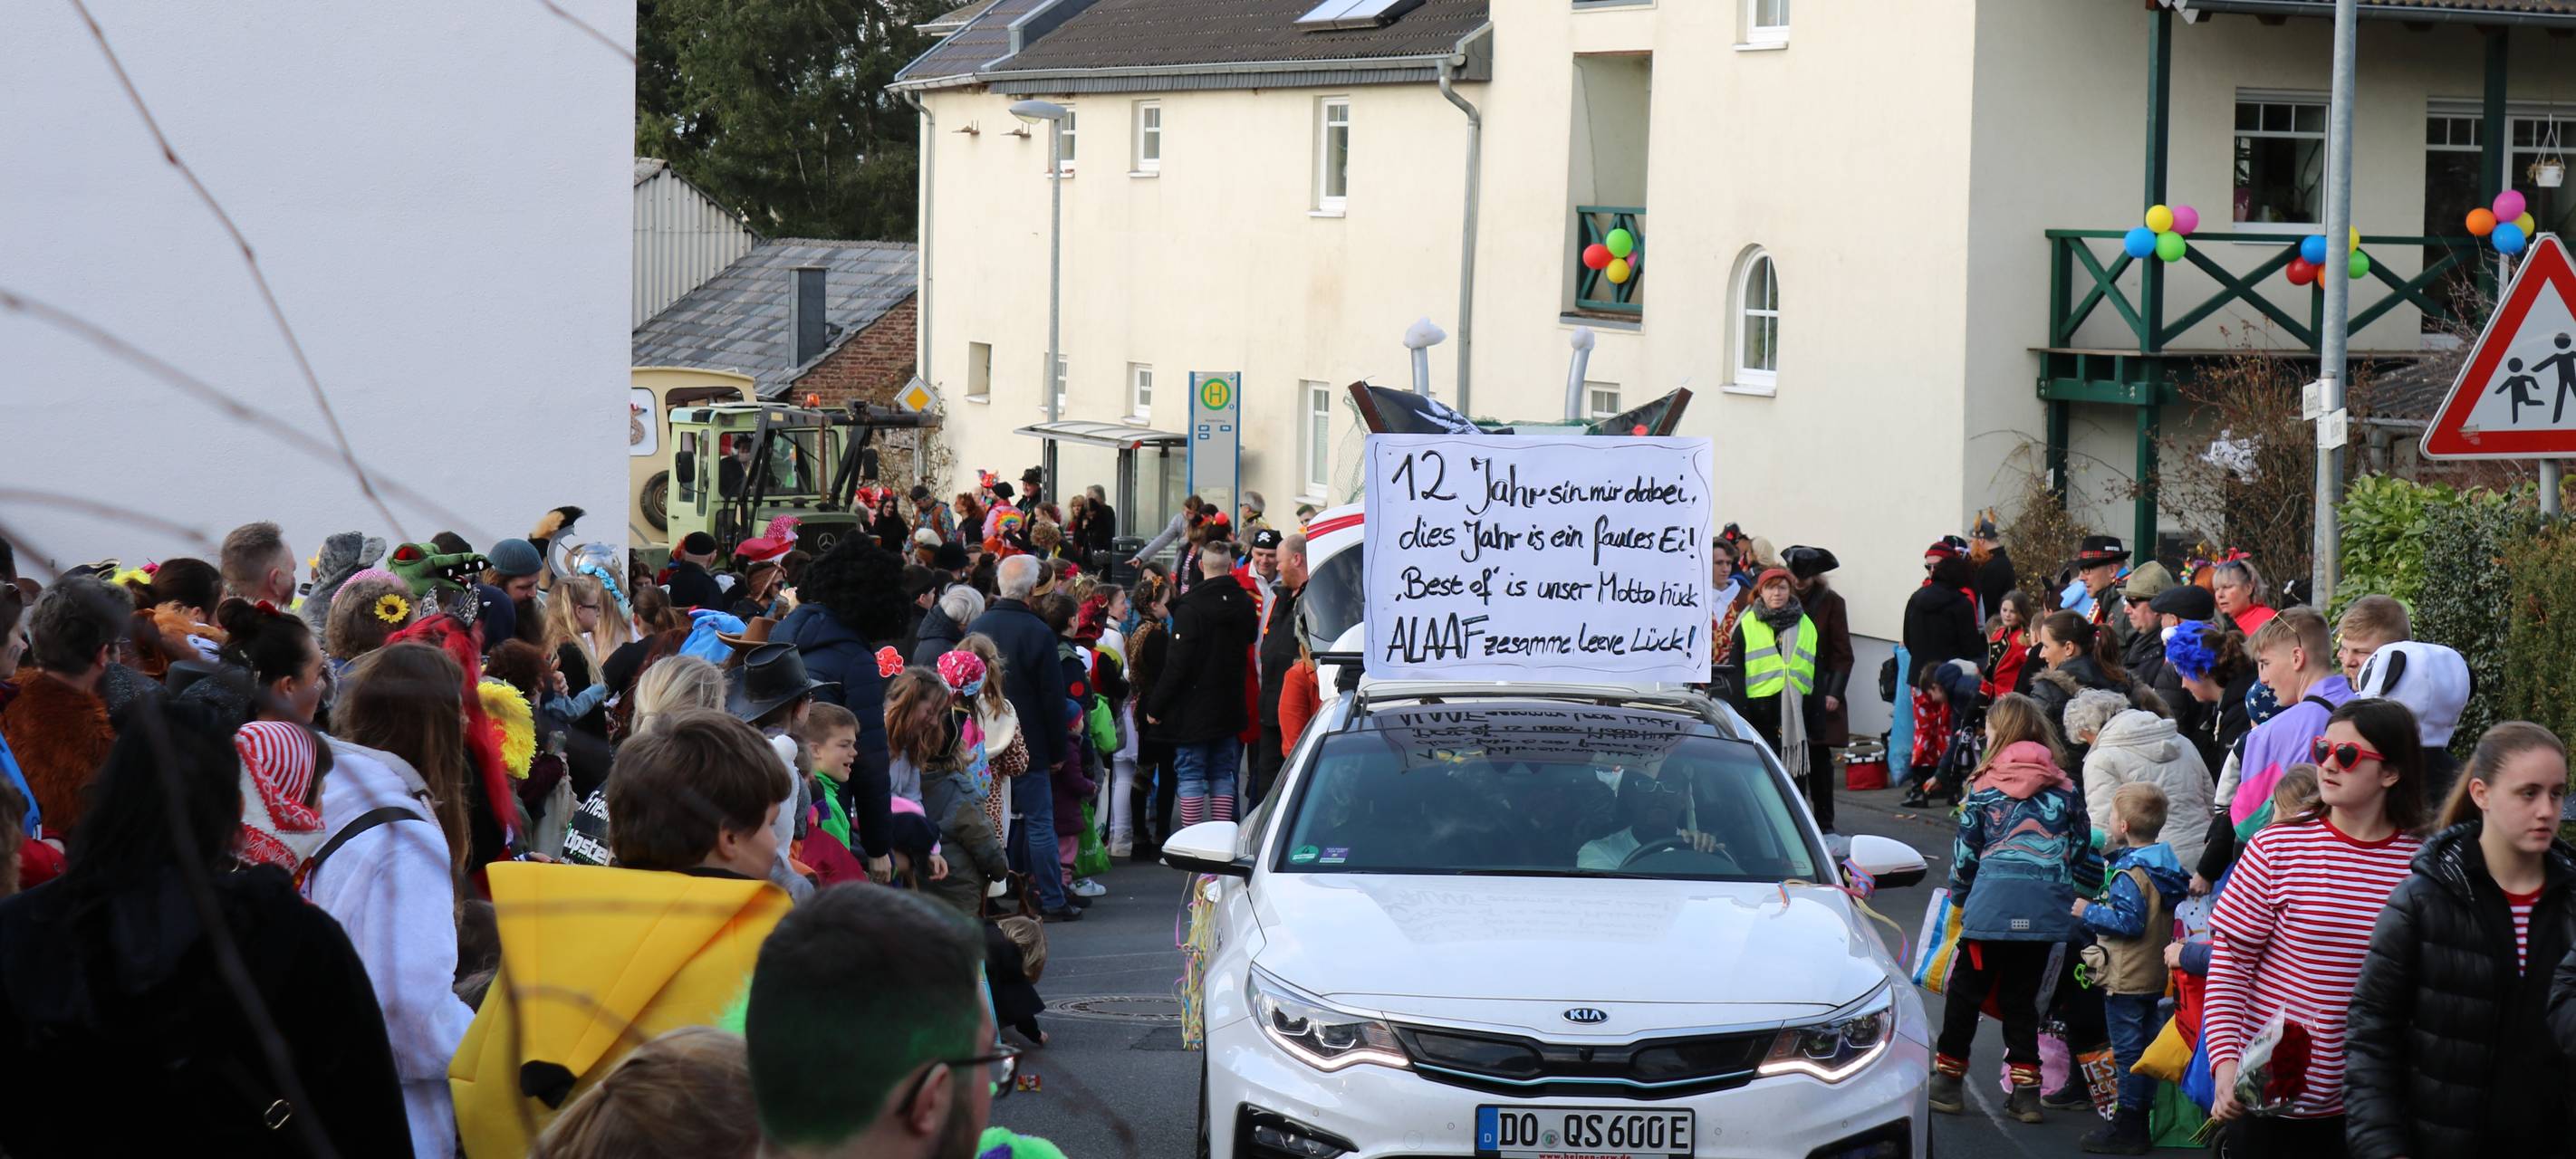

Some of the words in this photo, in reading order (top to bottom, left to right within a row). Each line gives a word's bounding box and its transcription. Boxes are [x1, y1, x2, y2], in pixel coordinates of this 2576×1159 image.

[1209, 386, 1222, 403] H
[1391, 449, 1457, 501] 12
[1466, 456, 1547, 518] Jahr
[1547, 480, 1588, 505] sin
[1590, 479, 1623, 503] mir
[1399, 514, 1456, 551] dies
[1460, 519, 1523, 563] Jahr
[1526, 523, 1545, 551] is
[1550, 524, 1584, 549] ein
[1592, 514, 1656, 567] faules
[1658, 525, 1696, 560] Ei!
[1505, 571, 1529, 598] is
[1537, 581, 1593, 601] unser
[1597, 570, 1657, 605] Motto
[1386, 612, 1490, 665] ALAAF
[1629, 625, 1697, 660] Lück!
[1570, 1009, 1602, 1020] KIA
[1484, 1134, 1492, 1143] D
[1499, 1113, 1539, 1146] DO
